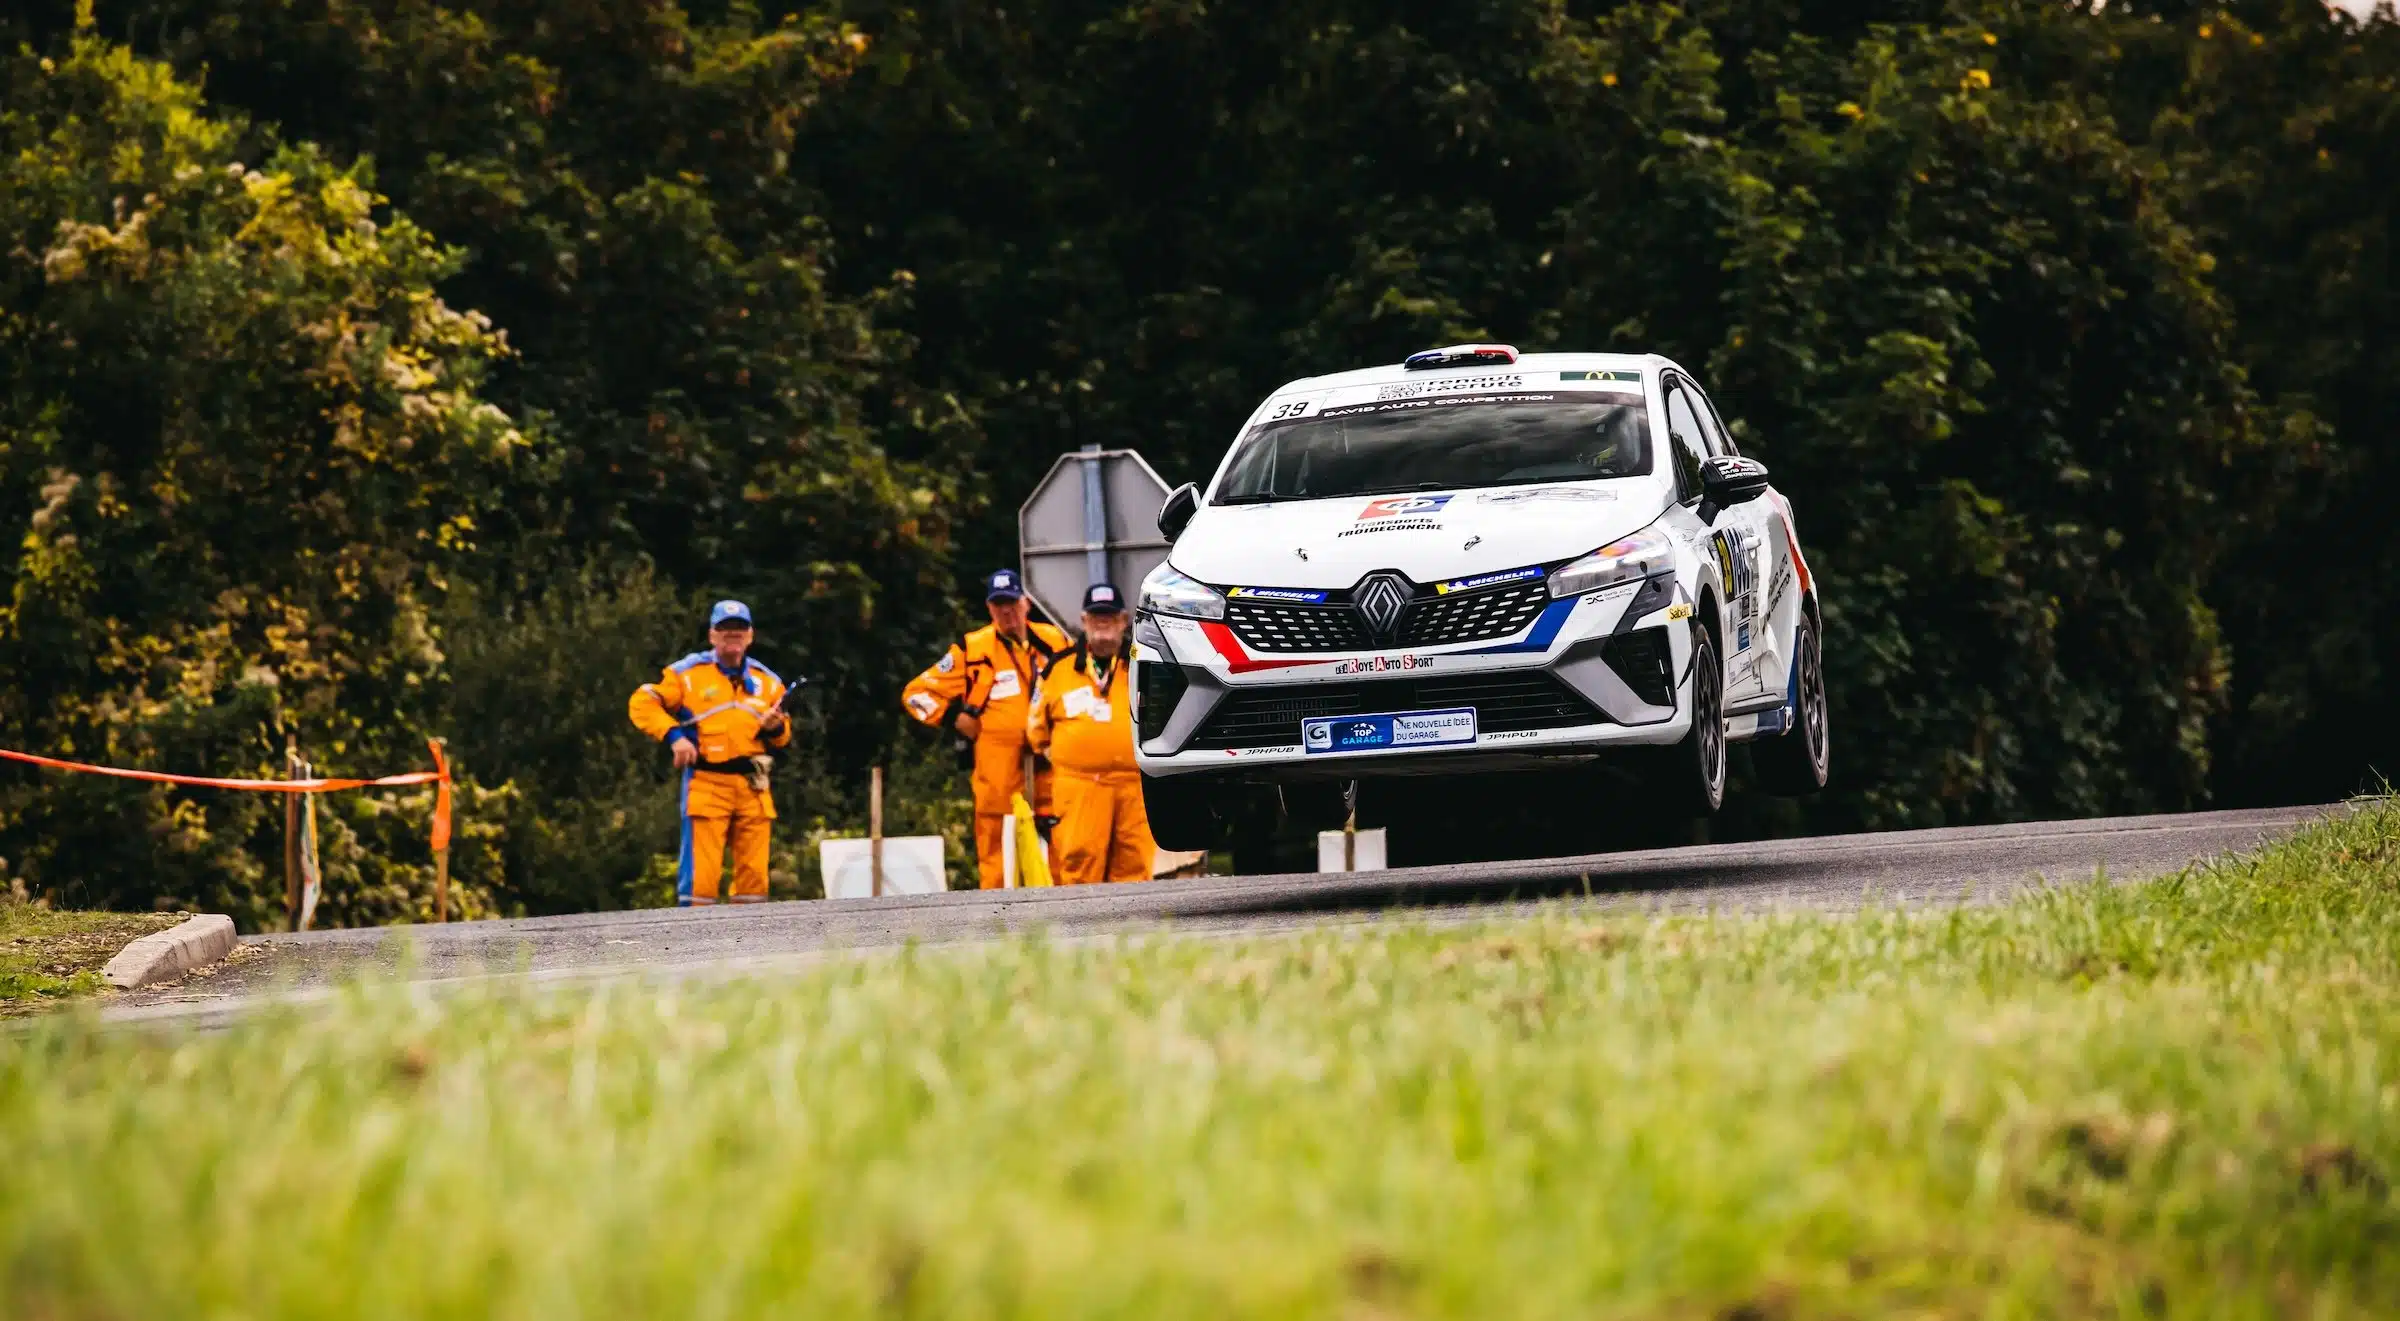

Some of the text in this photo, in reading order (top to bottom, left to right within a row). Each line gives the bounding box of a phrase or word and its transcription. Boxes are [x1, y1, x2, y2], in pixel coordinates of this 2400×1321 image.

[1429, 374, 1523, 385] renault
[1272, 402, 1309, 419] 39
[1323, 394, 1554, 417] DAVID AUTO COMPETITION
[1354, 518, 1434, 529] Transports
[1337, 524, 1445, 538] FROIDECONCHE
[1467, 570, 1535, 586] MICHELIN
[1256, 590, 1320, 600] MICHELIN
[1349, 659, 1374, 673] ROYE
[1375, 657, 1401, 671] AUTO
[1403, 655, 1434, 669] SPORT
[1412, 719, 1452, 729] NOUVELLE
[1354, 729, 1372, 737] TOP
[1396, 732, 1407, 741] DU
[1487, 731, 1538, 740] JPHPUB
[1342, 735, 1384, 745] GARAGE
[1244, 746, 1295, 756] JPHPUB
